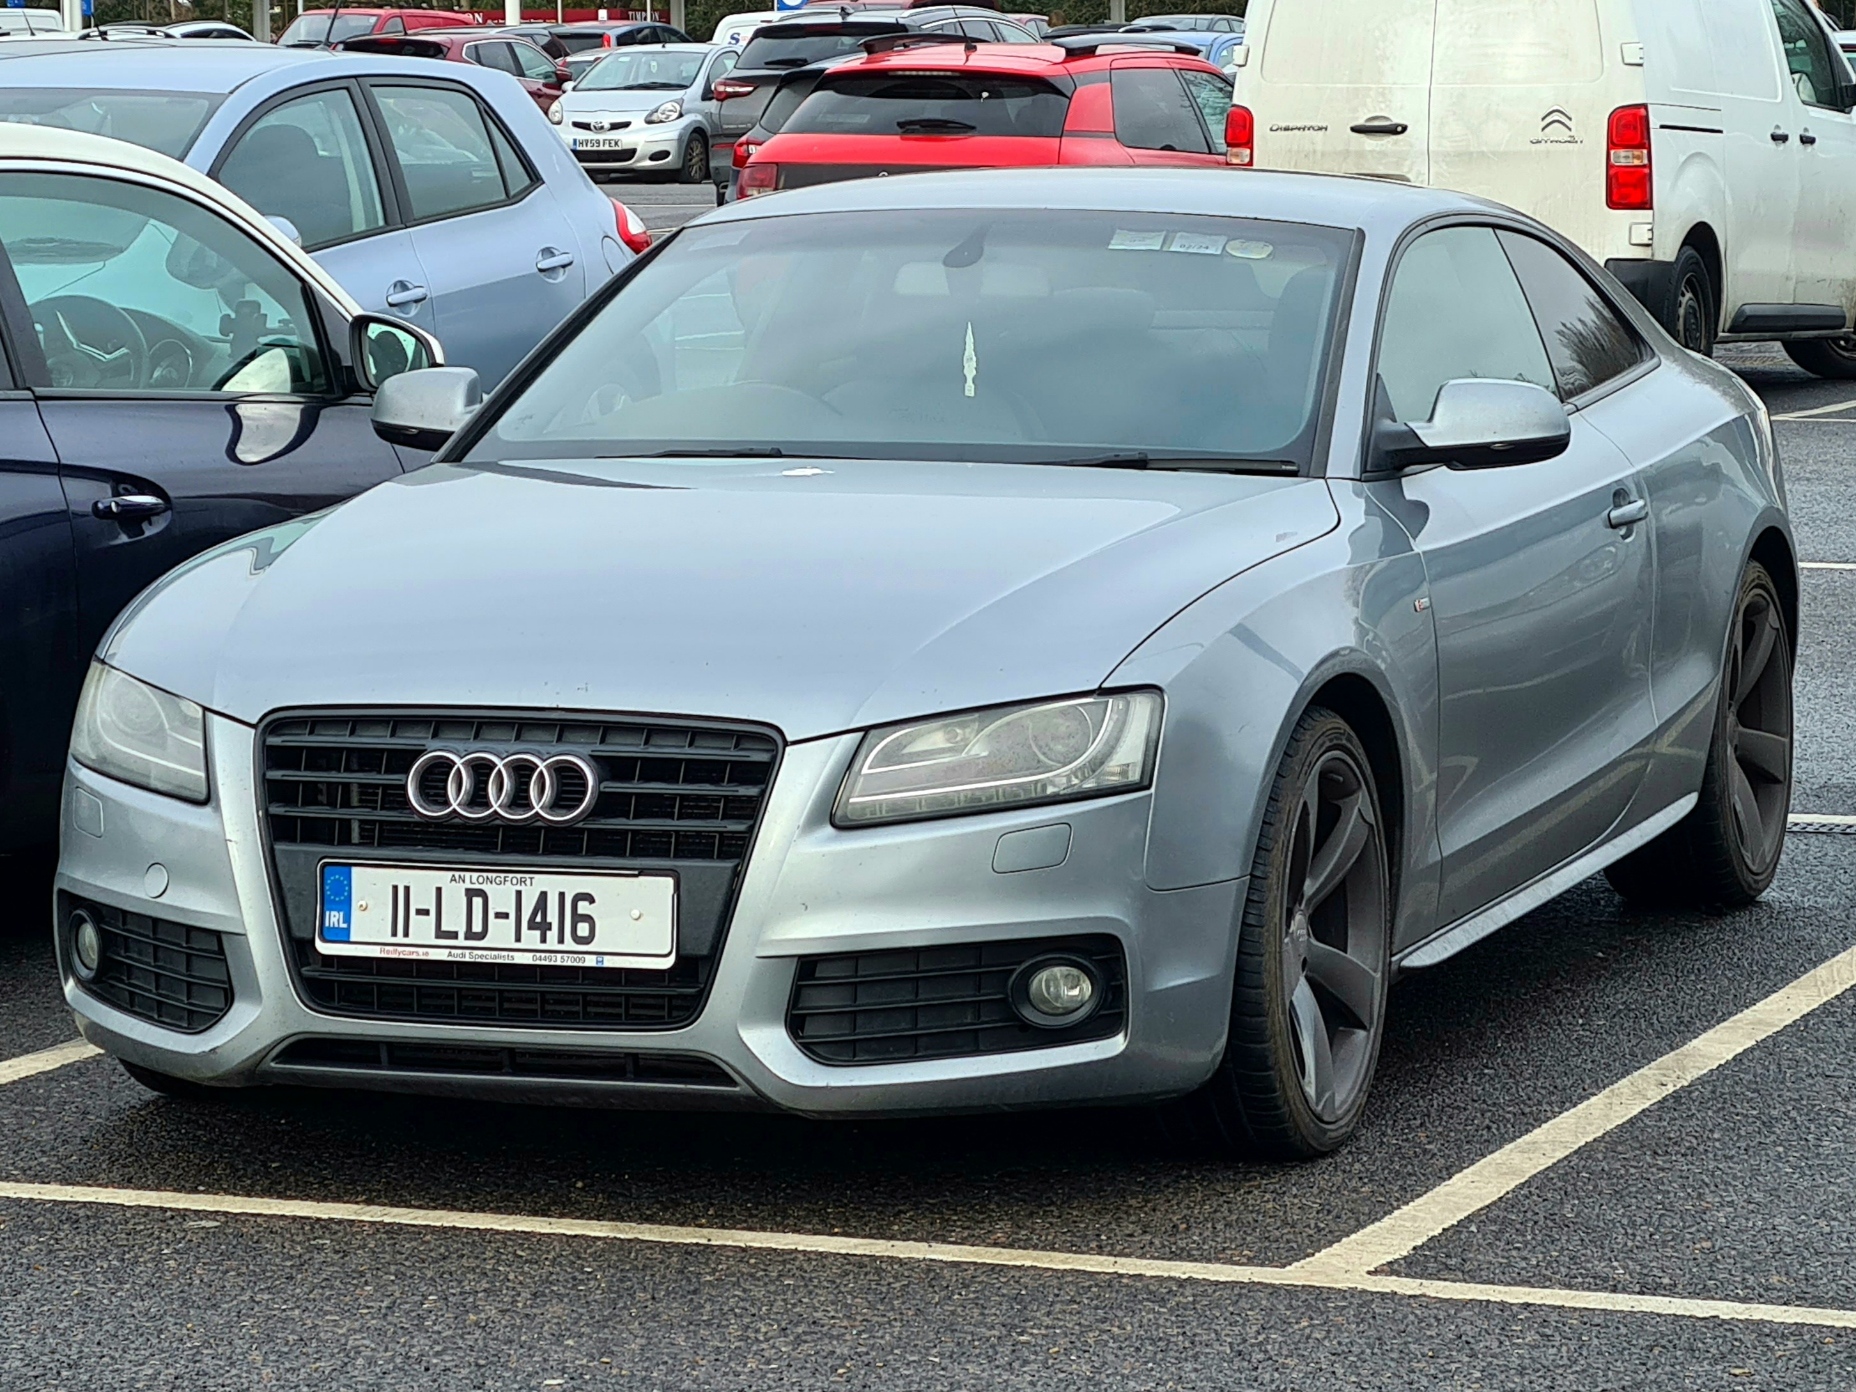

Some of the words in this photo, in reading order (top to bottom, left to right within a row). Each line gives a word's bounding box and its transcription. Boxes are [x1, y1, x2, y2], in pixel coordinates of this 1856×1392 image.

[628, 11, 660, 22] TIMPON
[602, 138, 620, 148] FEK
[449, 873, 466, 884] AN
[469, 874, 535, 887] LONGFORT
[325, 910, 348, 928] IRL
[390, 884, 597, 946] 11-LD-1416
[446, 950, 467, 959] Audi
[468, 951, 515, 962] Specialists
[531, 953, 558, 963] 04493
[560, 954, 586, 964] 57009
